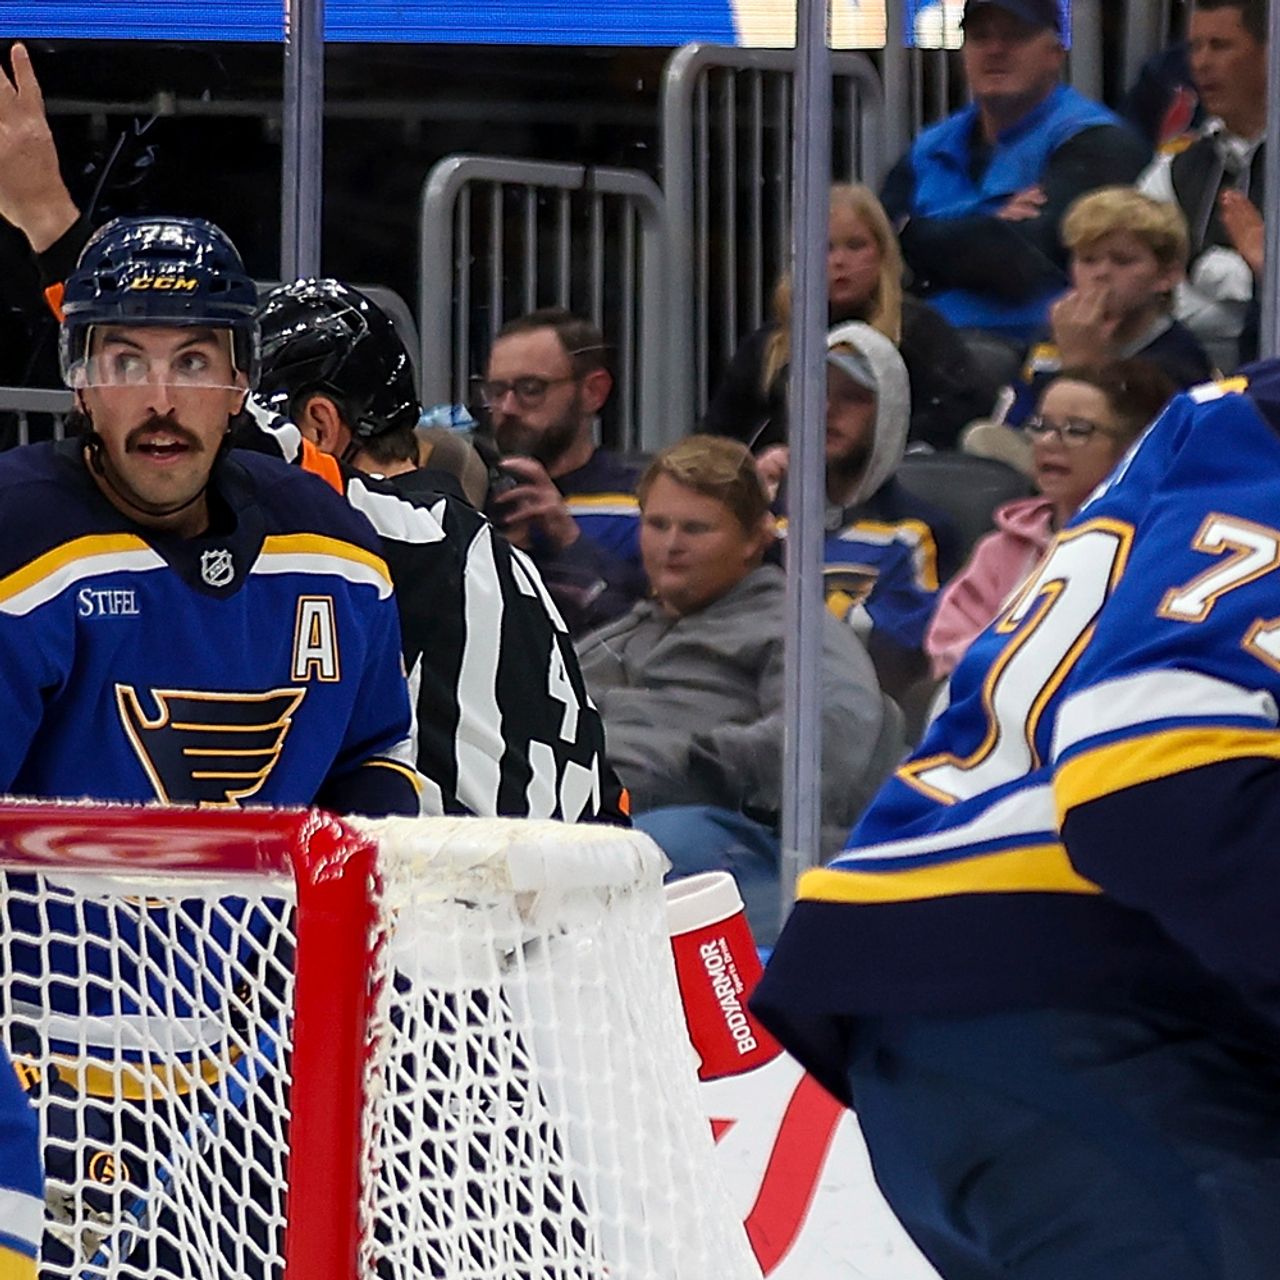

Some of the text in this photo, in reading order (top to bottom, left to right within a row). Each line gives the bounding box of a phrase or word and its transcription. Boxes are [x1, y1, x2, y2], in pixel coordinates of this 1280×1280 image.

[131, 275, 198, 291] CCM
[79, 587, 140, 617] STIFEL
[291, 595, 340, 682] A
[718, 936, 744, 995] Sports Drink
[700, 939, 757, 1055] BODYARMOR
